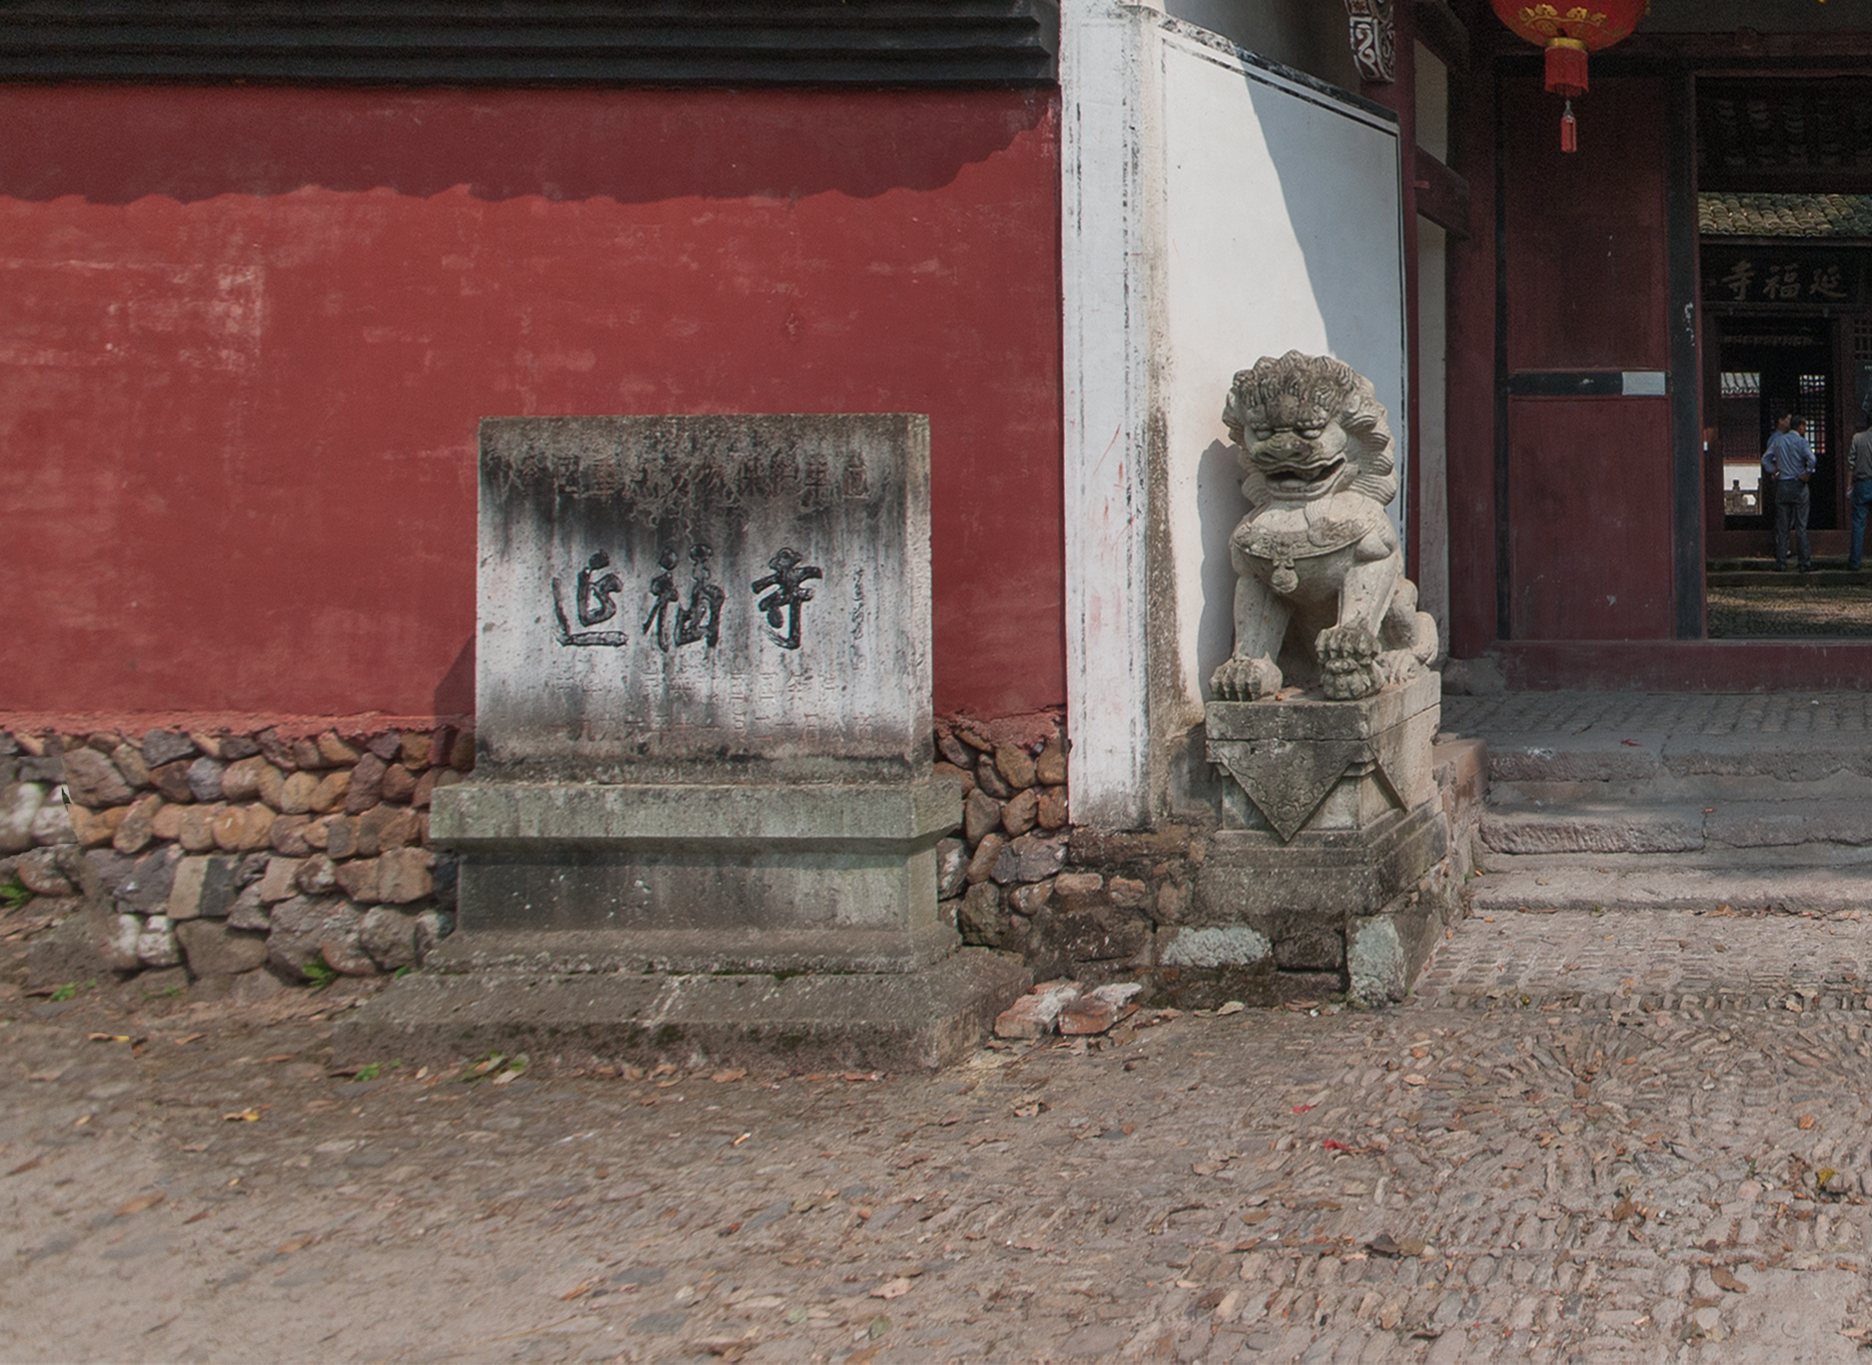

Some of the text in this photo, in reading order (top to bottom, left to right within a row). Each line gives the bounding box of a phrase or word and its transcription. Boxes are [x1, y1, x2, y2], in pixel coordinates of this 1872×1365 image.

[1721, 260, 1848, 301] 延福寺
[551, 543, 823, 652] 延福寺
